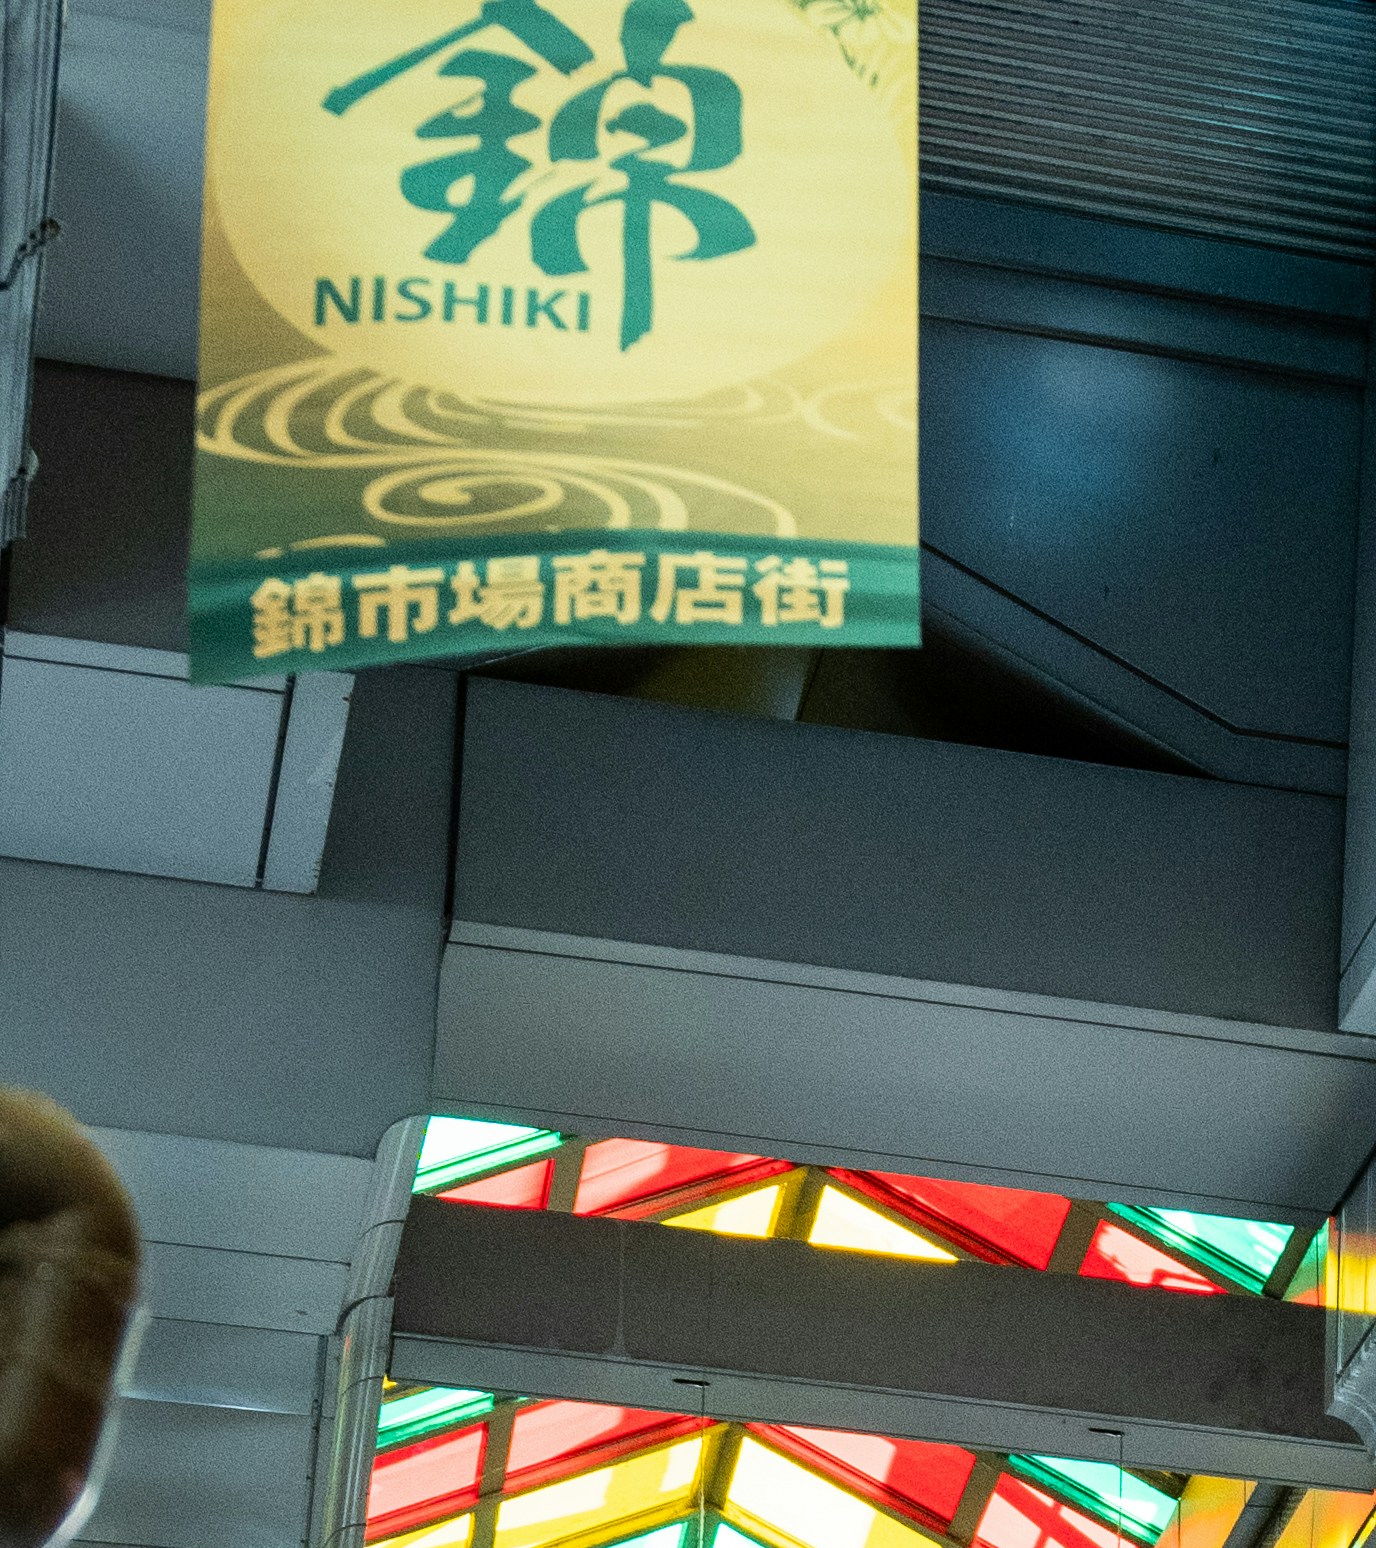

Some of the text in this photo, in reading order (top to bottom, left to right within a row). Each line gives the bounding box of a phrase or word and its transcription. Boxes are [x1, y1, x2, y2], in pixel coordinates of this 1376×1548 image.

[322, 0, 756, 351] 錦
[313, 275, 591, 333] NISHIKI
[251, 550, 850, 660] 錦市場商店街
